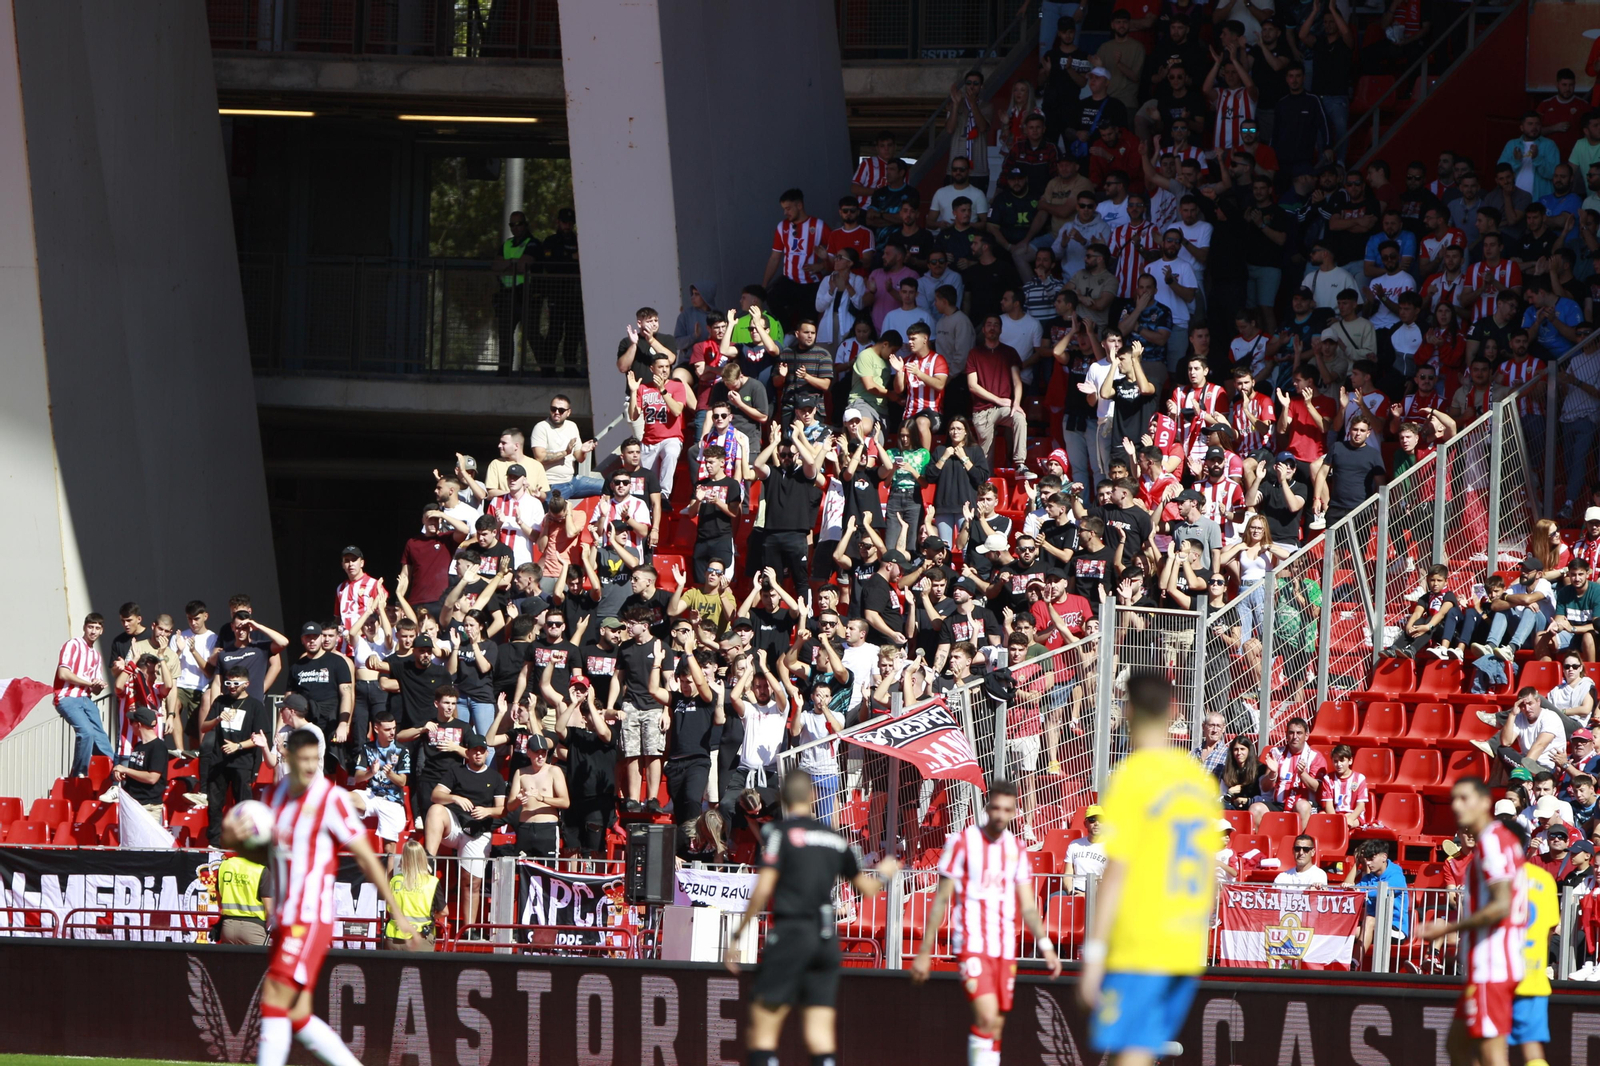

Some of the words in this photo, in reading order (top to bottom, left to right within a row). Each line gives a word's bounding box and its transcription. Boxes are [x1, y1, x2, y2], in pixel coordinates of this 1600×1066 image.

[645, 405, 667, 425] 24
[1073, 851, 1107, 865] HILFIGER
[1228, 889, 1281, 911] PEÑA
[1285, 892, 1312, 913] LA
[1316, 894, 1357, 914] UVA
[328, 963, 740, 1066] CASTORE
